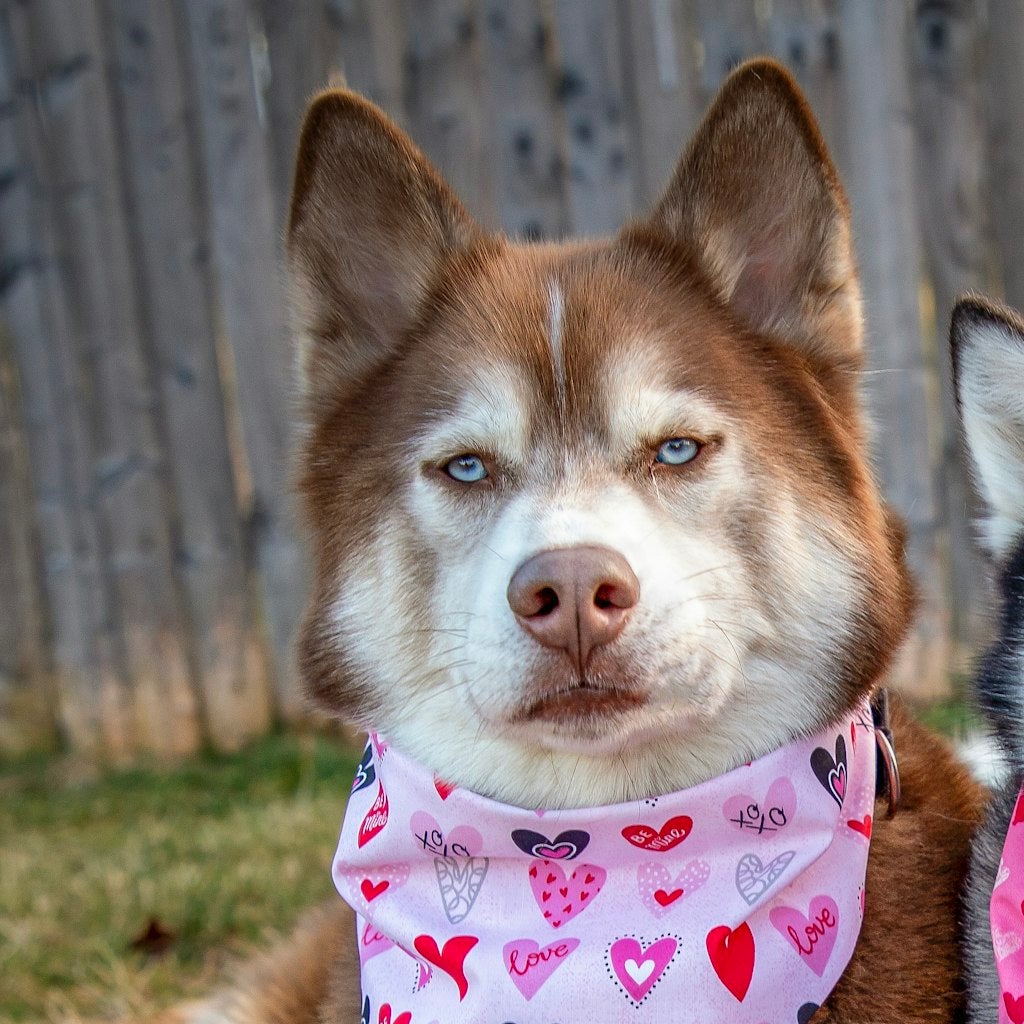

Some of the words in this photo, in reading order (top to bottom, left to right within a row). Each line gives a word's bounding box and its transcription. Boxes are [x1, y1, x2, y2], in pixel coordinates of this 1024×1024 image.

[631, 830, 653, 843] BE
[787, 906, 836, 955] love
[509, 944, 569, 975] love
